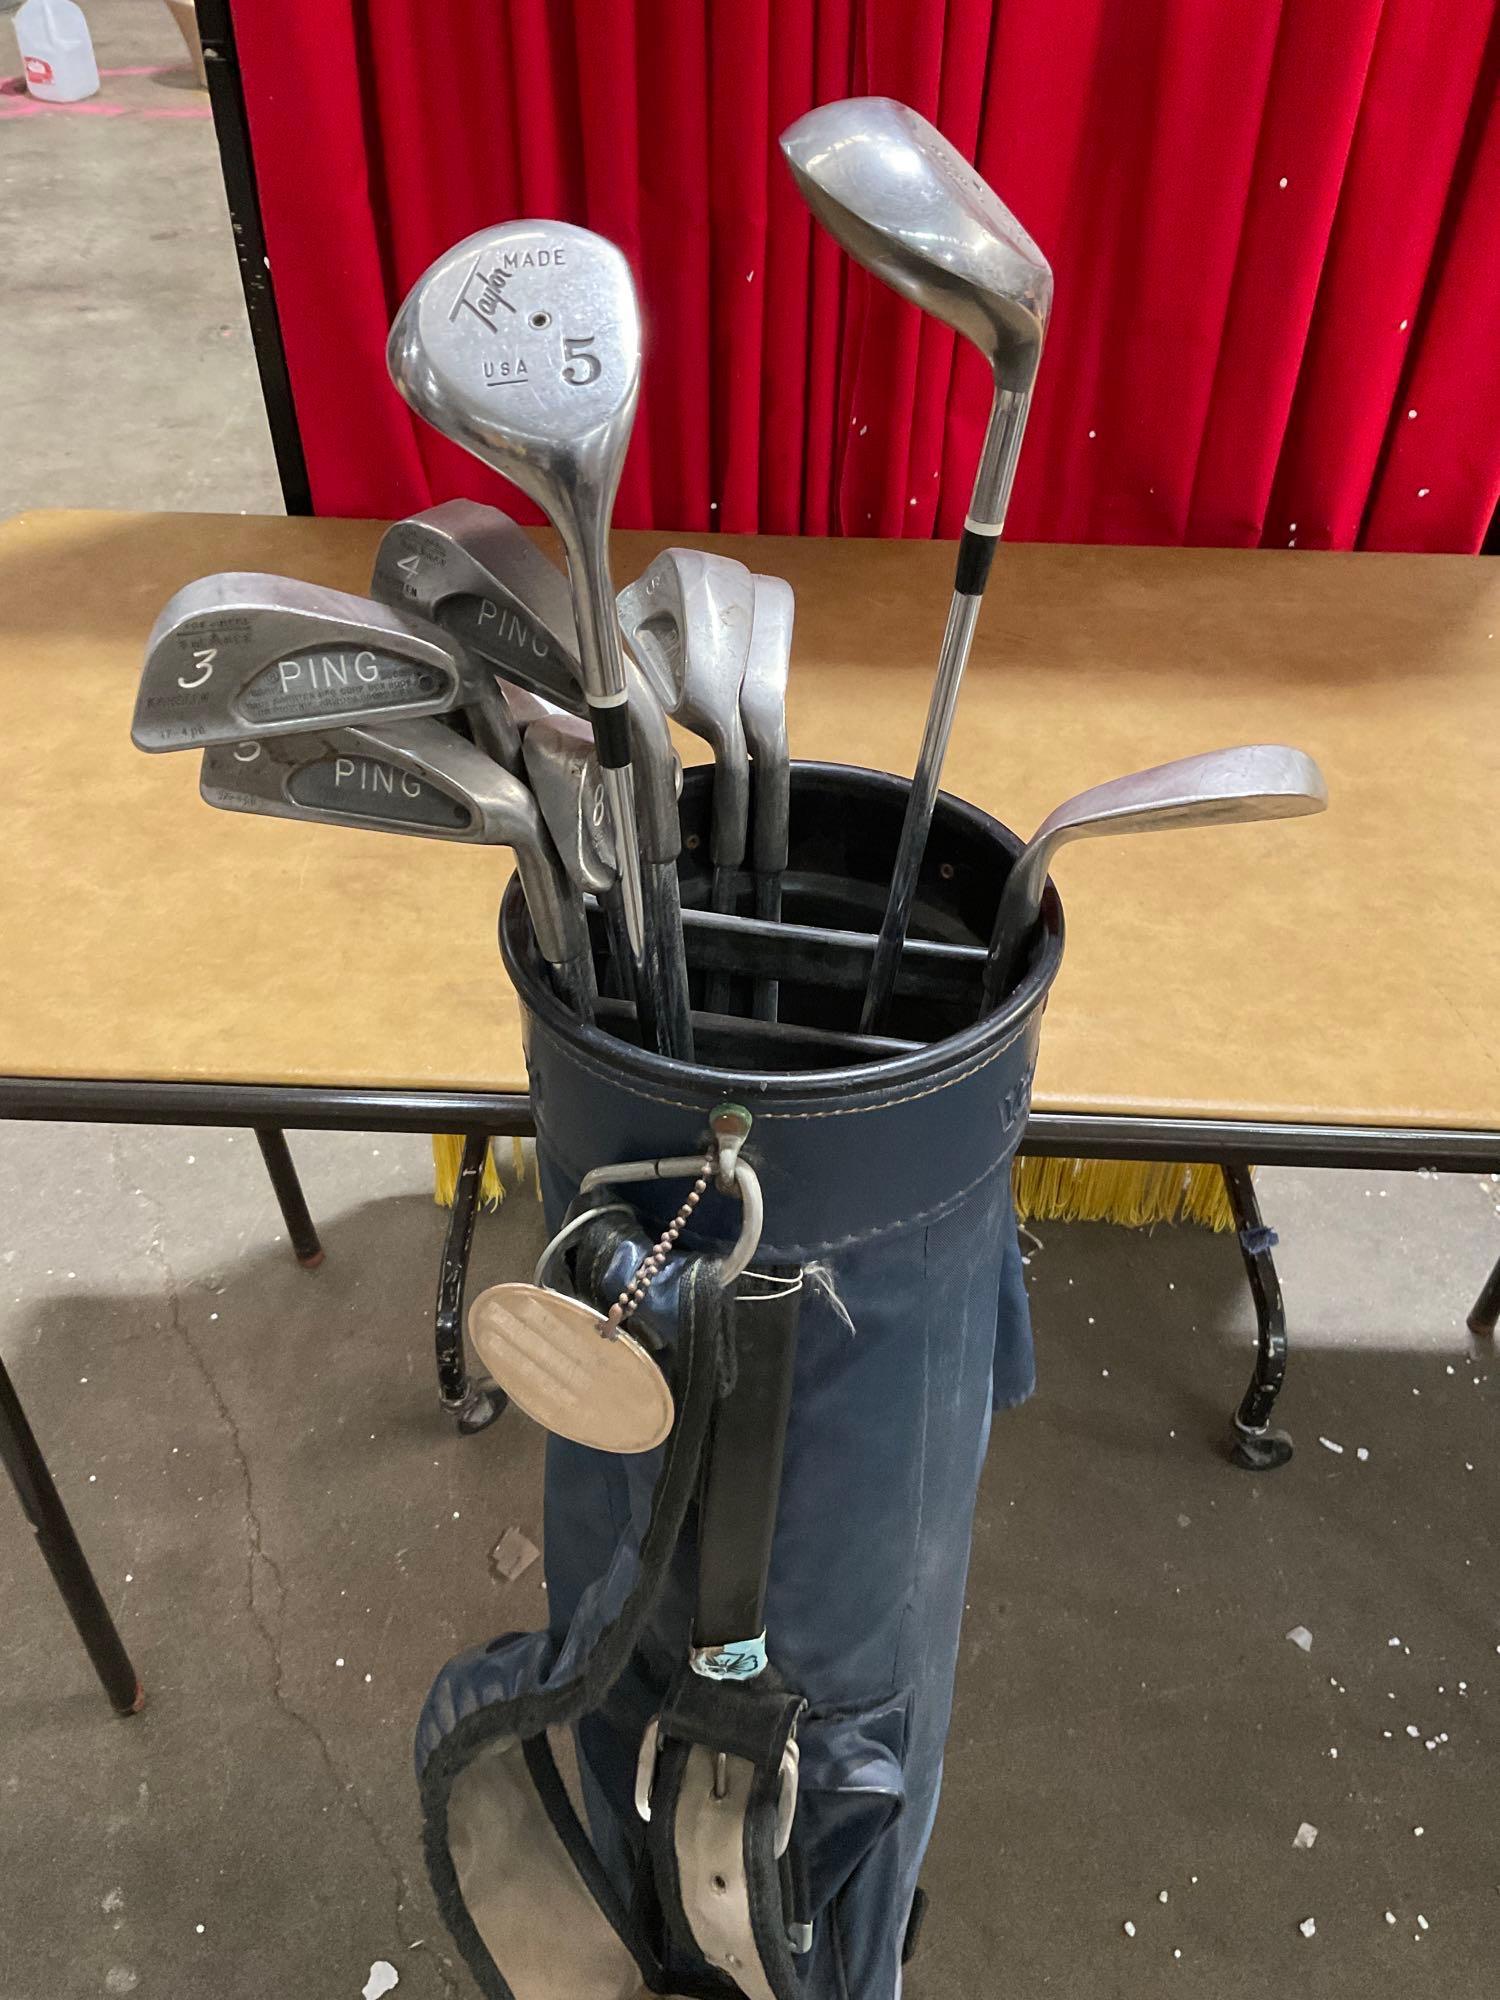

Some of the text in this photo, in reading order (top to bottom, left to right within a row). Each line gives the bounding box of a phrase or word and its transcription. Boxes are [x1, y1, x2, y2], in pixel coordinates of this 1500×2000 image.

[448, 249, 566, 334] Taylor MADE
[483, 359, 529, 378] USA
[562, 336, 602, 386] 5
[396, 555, 421, 580] 4
[477, 598, 549, 657] PING
[177, 648, 218, 689] 3
[277, 650, 380, 693] PING
[335, 758, 421, 798] PING
[592, 783, 605, 827] 8
